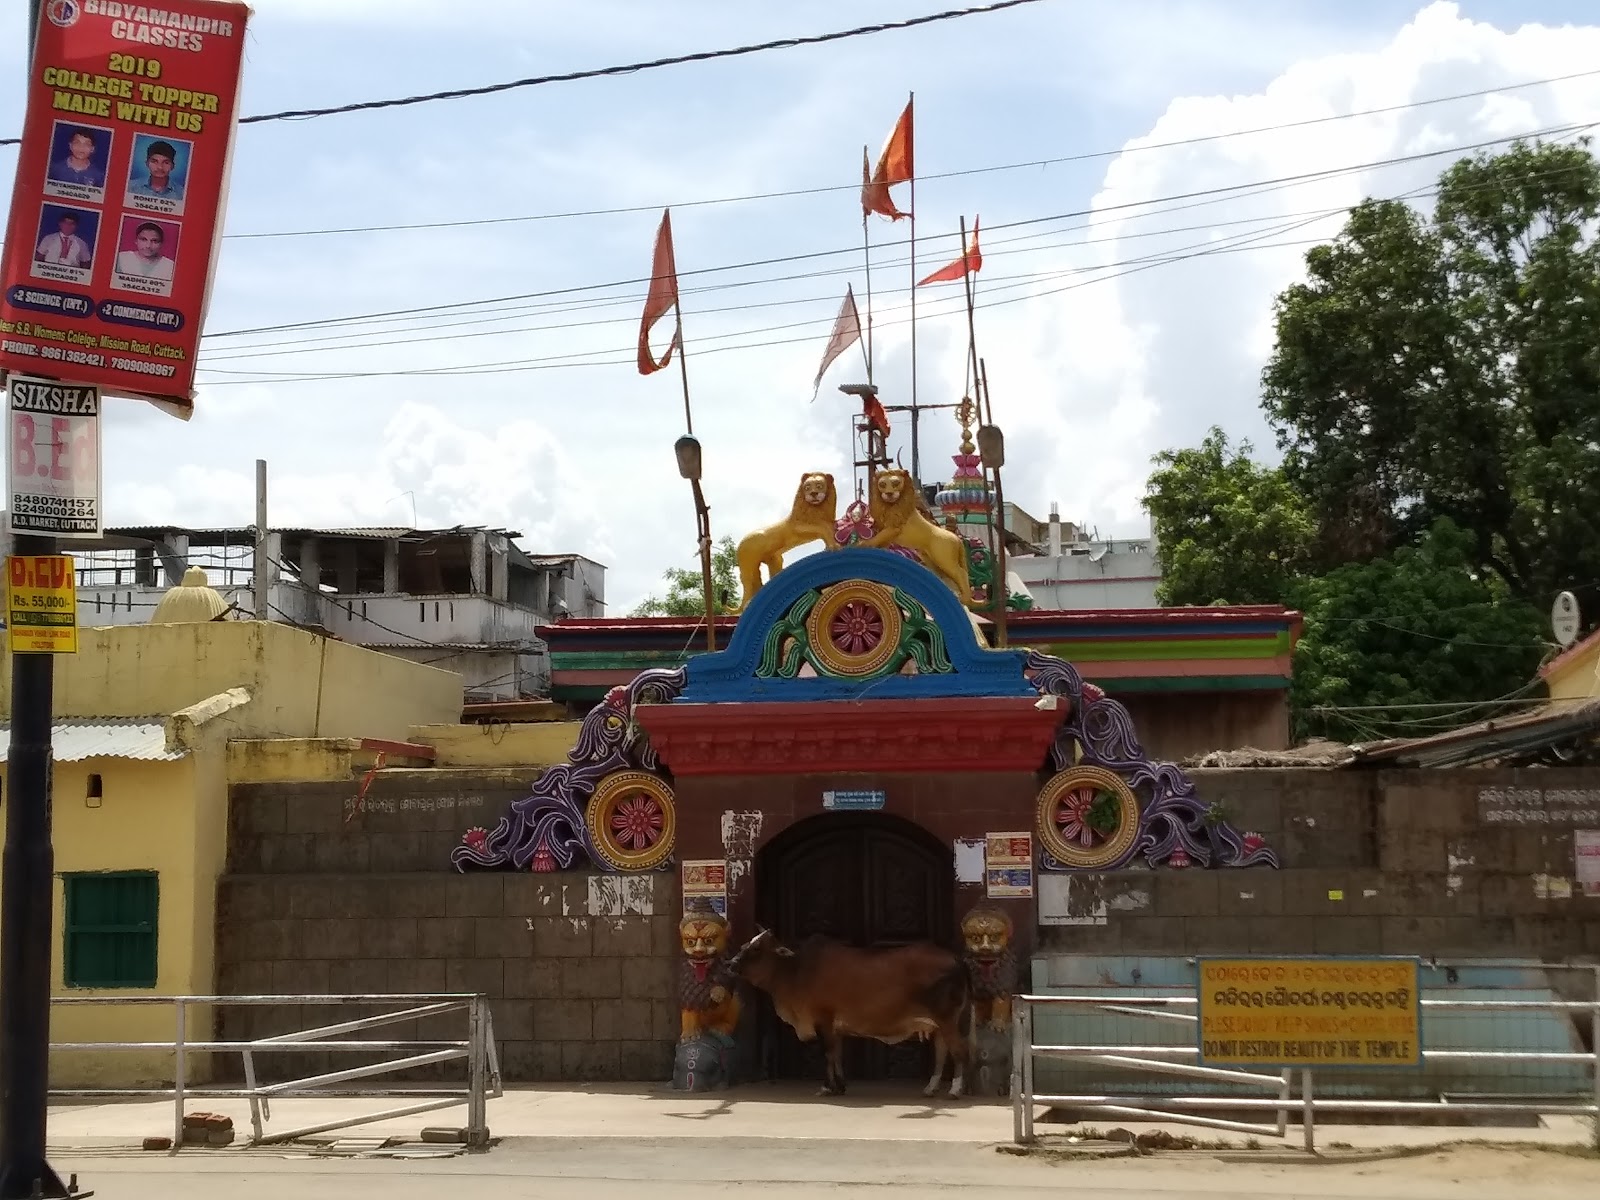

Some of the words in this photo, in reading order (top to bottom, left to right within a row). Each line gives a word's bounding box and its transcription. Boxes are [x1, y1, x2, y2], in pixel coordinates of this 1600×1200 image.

[83, 0, 233, 37] BIDYAMANDIR
[111, 20, 203, 53] CLASSES
[108, 53, 161, 78] 2019
[43, 67, 134, 99] COLLEGE
[138, 83, 220, 113] TOPPER
[52, 90, 112, 118] MADE
[116, 101, 171, 129] WITH
[175, 111, 204, 133] US
[118, 275, 148, 284] MADHU
[25, 291, 61, 308] SCIENCE
[62, 297, 88, 313] (INT.)
[102, 304, 112, 315] +2
[112, 306, 155, 323] COMMERCE
[156, 310, 180, 327] (INT.)
[1, 340, 39, 357] PHONE:
[33, 325, 65, 342] Womens
[99, 335, 129, 351] Mission
[130, 339, 153, 356] Road,
[154, 344, 186, 360] Cuttack.
[12, 383, 97, 414] SIKSHA
[14, 494, 95, 508] 8480741157
[14, 504, 95, 517] 8249000264
[13, 516, 28, 526] A.D.
[61, 519, 97, 530] CUTTACK
[13, 595, 29, 607] Rs.
[1203, 1041, 1219, 1057] DO
[1239, 1041, 1281, 1057] DESTROY
[1323, 1041, 1337, 1057] OF
[1339, 1041, 1361, 1057] THE
[1365, 1041, 1410, 1058] TEMPLE
